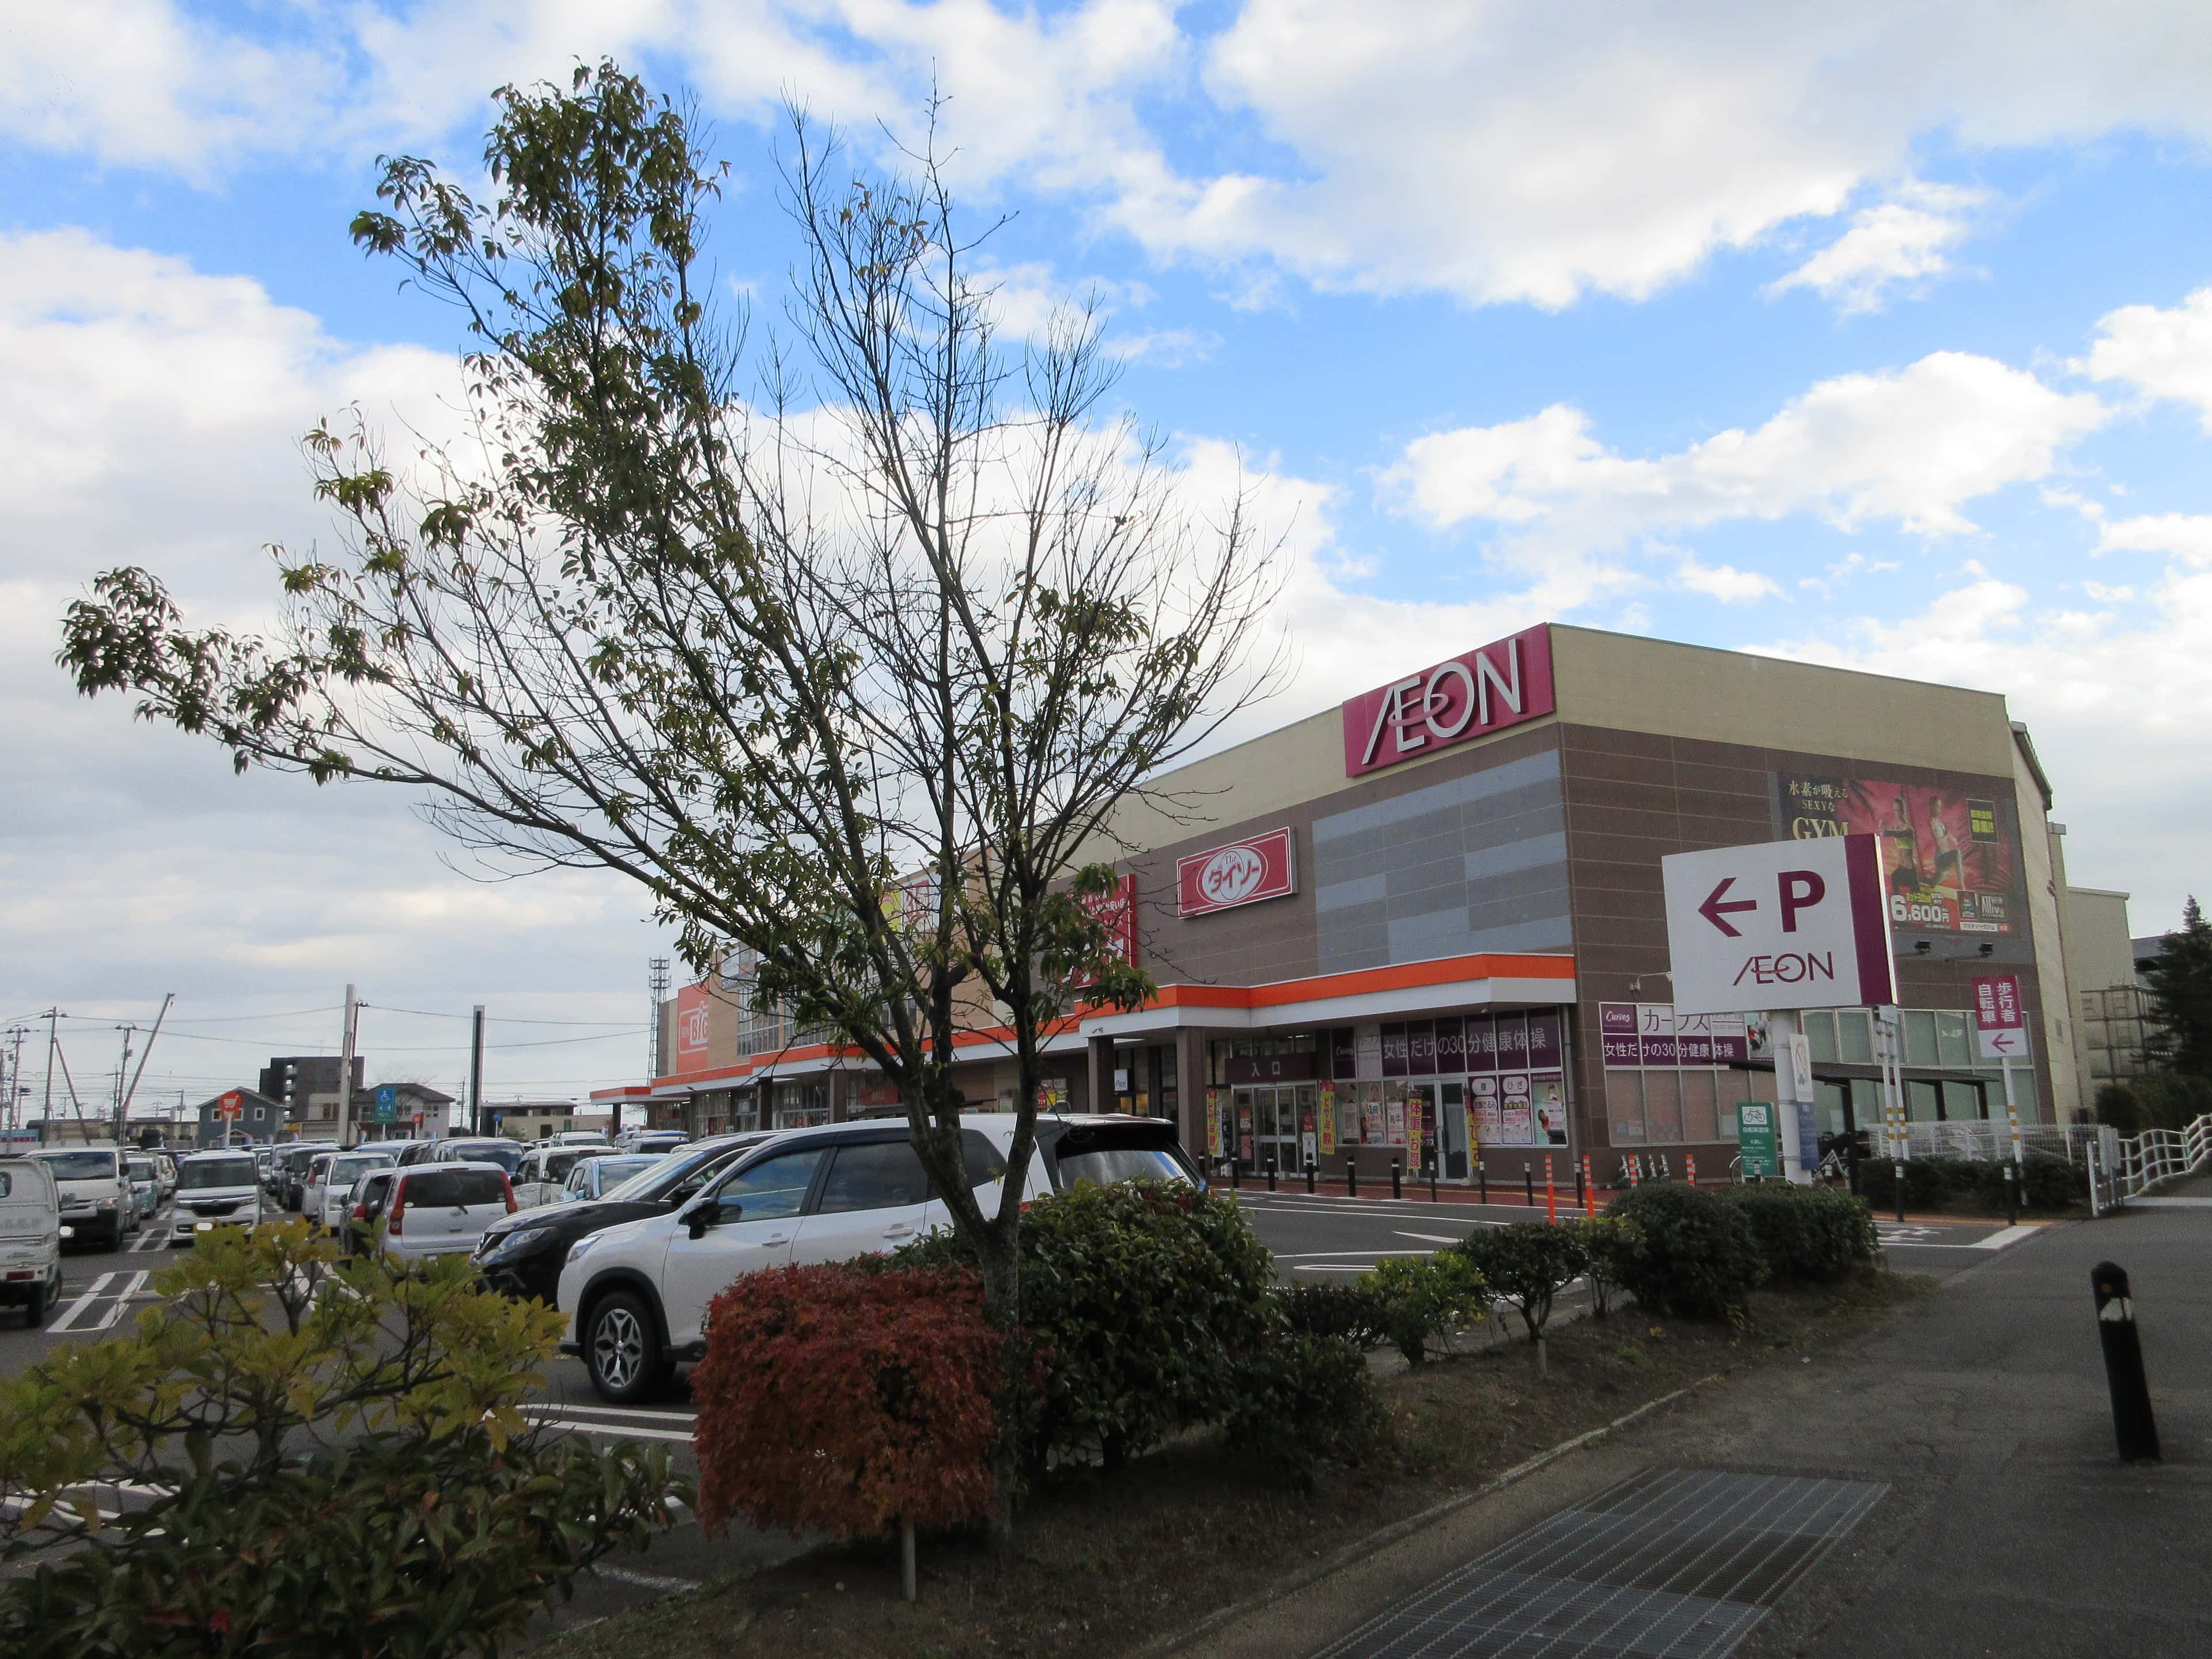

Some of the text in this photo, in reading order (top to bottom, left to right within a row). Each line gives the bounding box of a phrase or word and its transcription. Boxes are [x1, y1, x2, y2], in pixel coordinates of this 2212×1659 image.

[1792, 817, 1849, 840] GYM
[1225, 855, 1237, 864] The
[1209, 858, 1260, 895] ダイソー
[1777, 870, 1825, 933] P
[1978, 983, 1997, 1023] 自転車
[1997, 982, 2016, 1022] 歩行者
[1384, 1028, 1547, 1059] 女性だけの30分健康体操
[1604, 1041, 1734, 1058] 女性だけの30分健康体操
[1251, 1061, 1281, 1077] 入口
